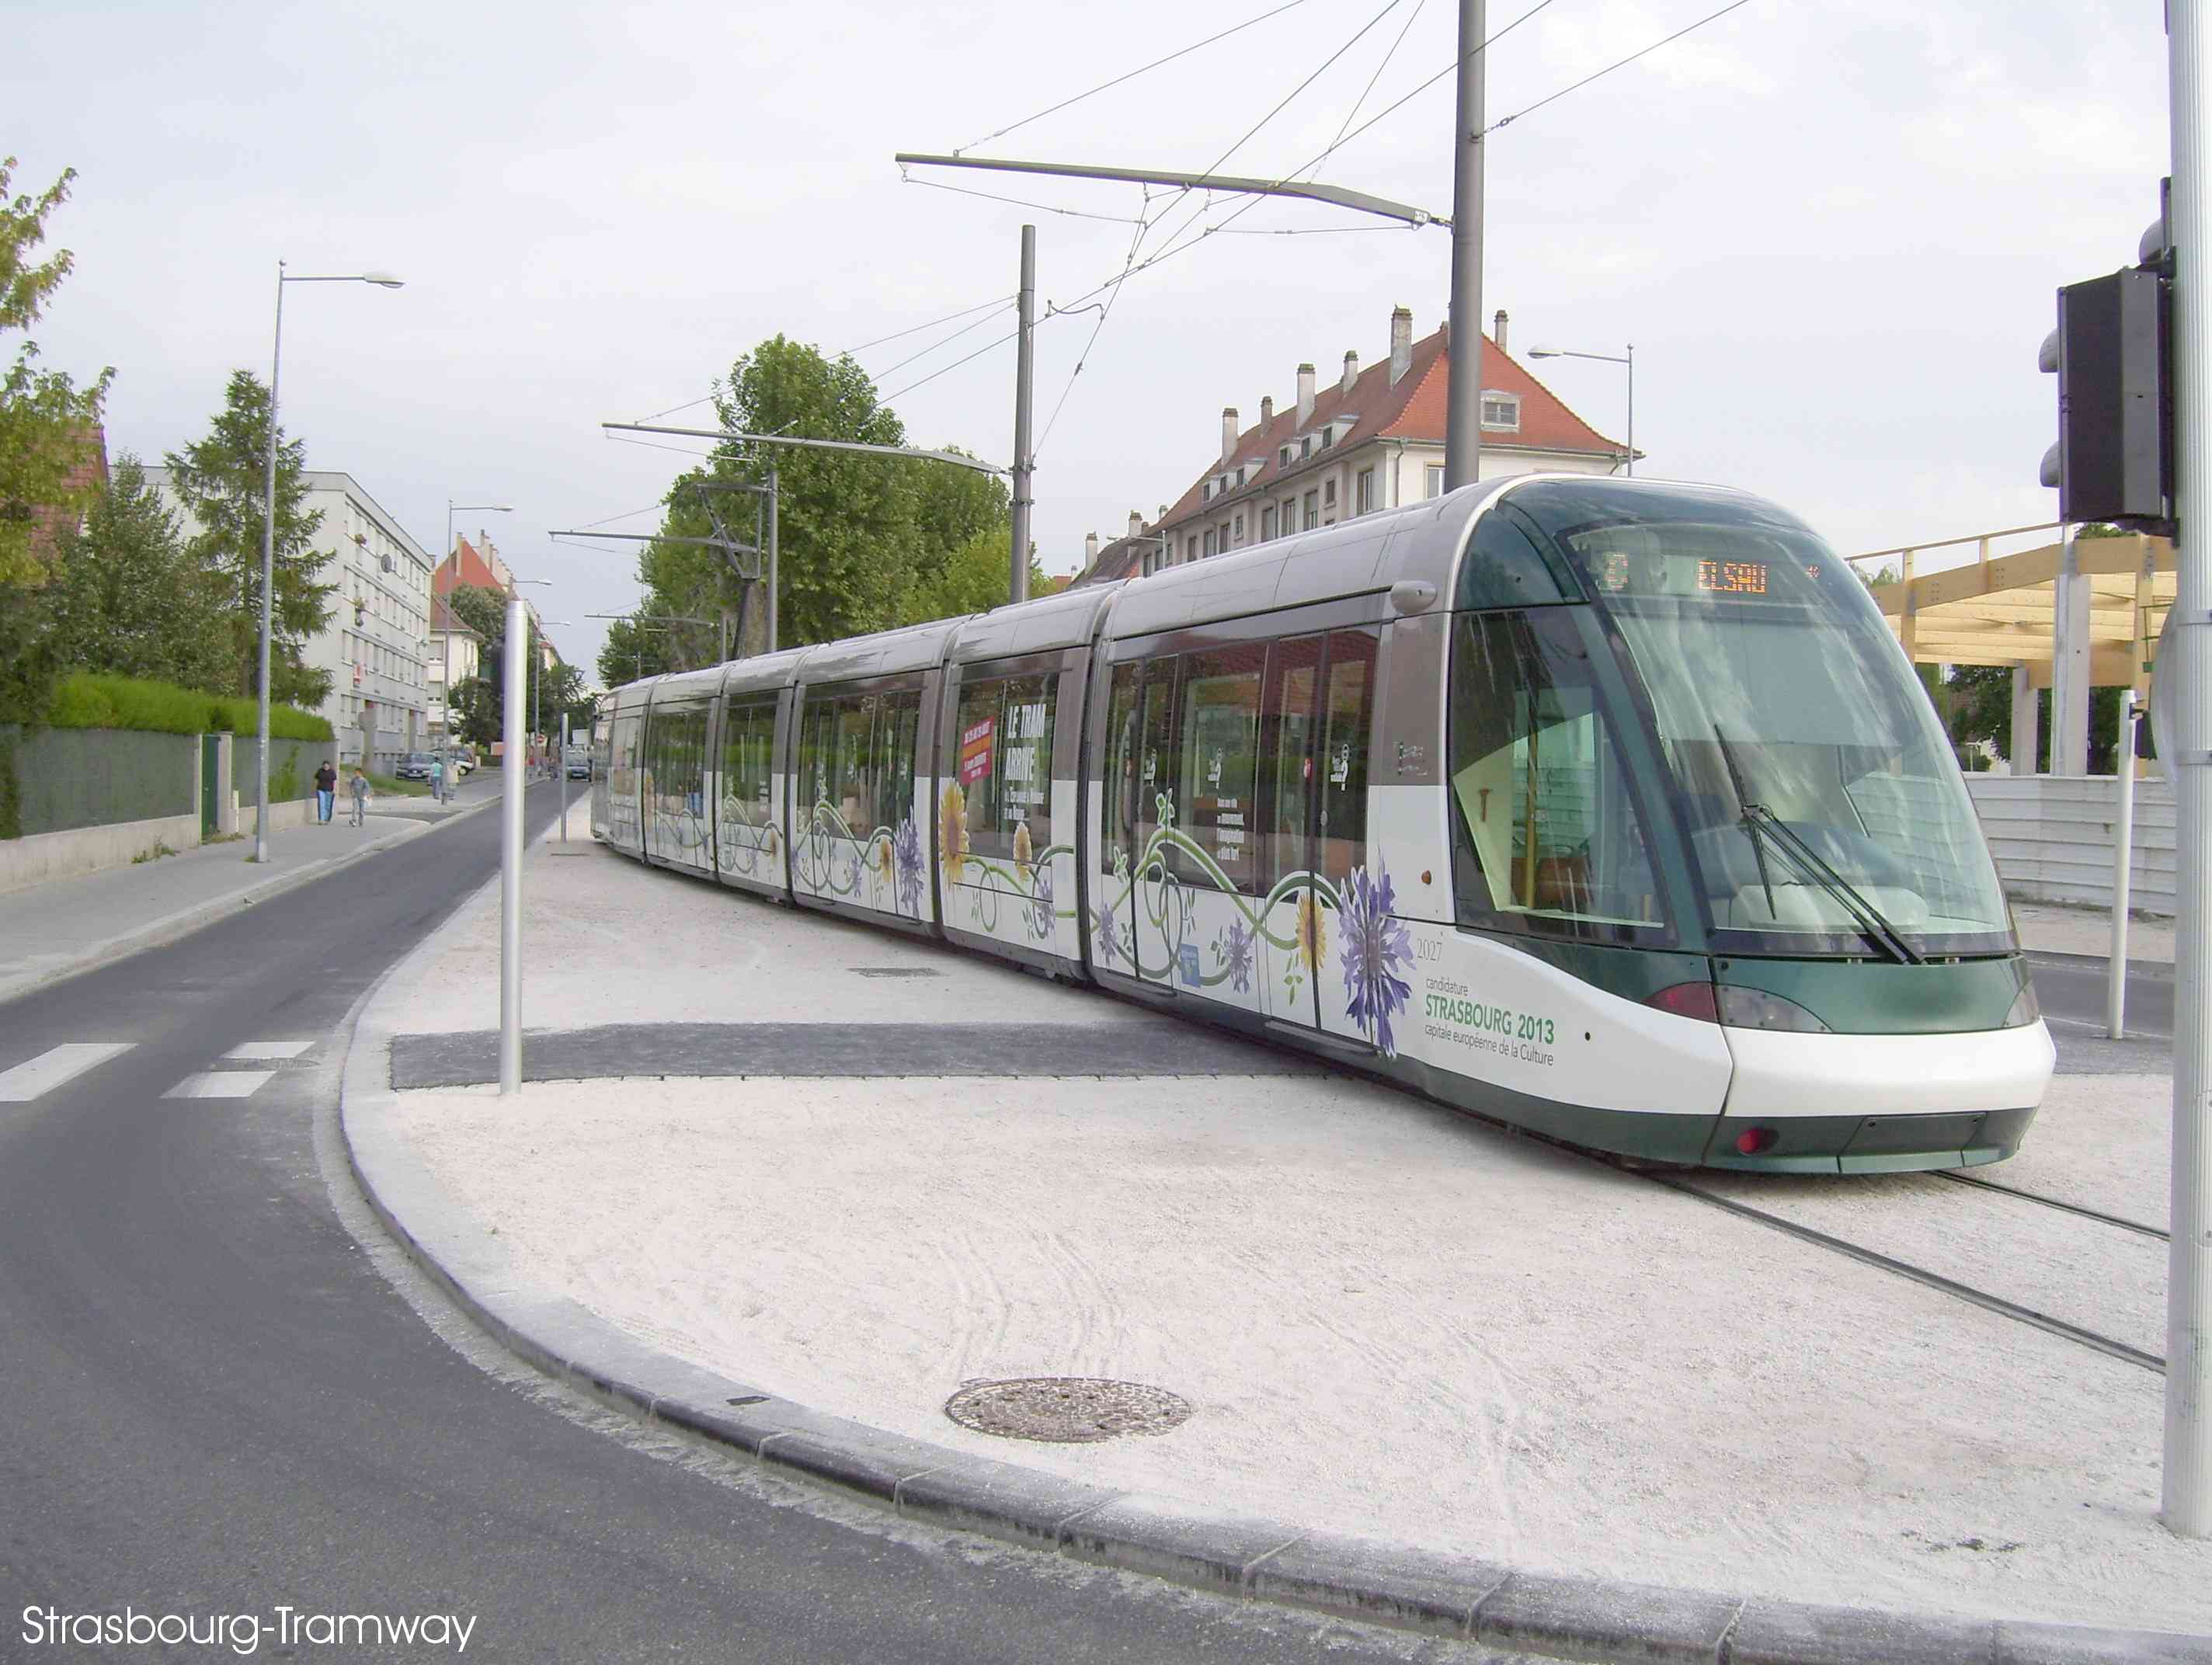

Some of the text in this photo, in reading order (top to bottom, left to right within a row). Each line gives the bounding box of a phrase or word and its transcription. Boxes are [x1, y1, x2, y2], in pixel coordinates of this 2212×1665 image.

[1698, 559, 1766, 593] ELSAU
[1007, 705, 1019, 739] LE
[1020, 704, 1046, 738] TRAM
[1005, 746, 1036, 781] ARRIVE
[1416, 937, 1443, 962] 2027
[1425, 976, 1469, 997] candidature
[1425, 993, 1555, 1045] STRASBOURG 2013
[1424, 1023, 1554, 1066] capitale européenne de la Culture
